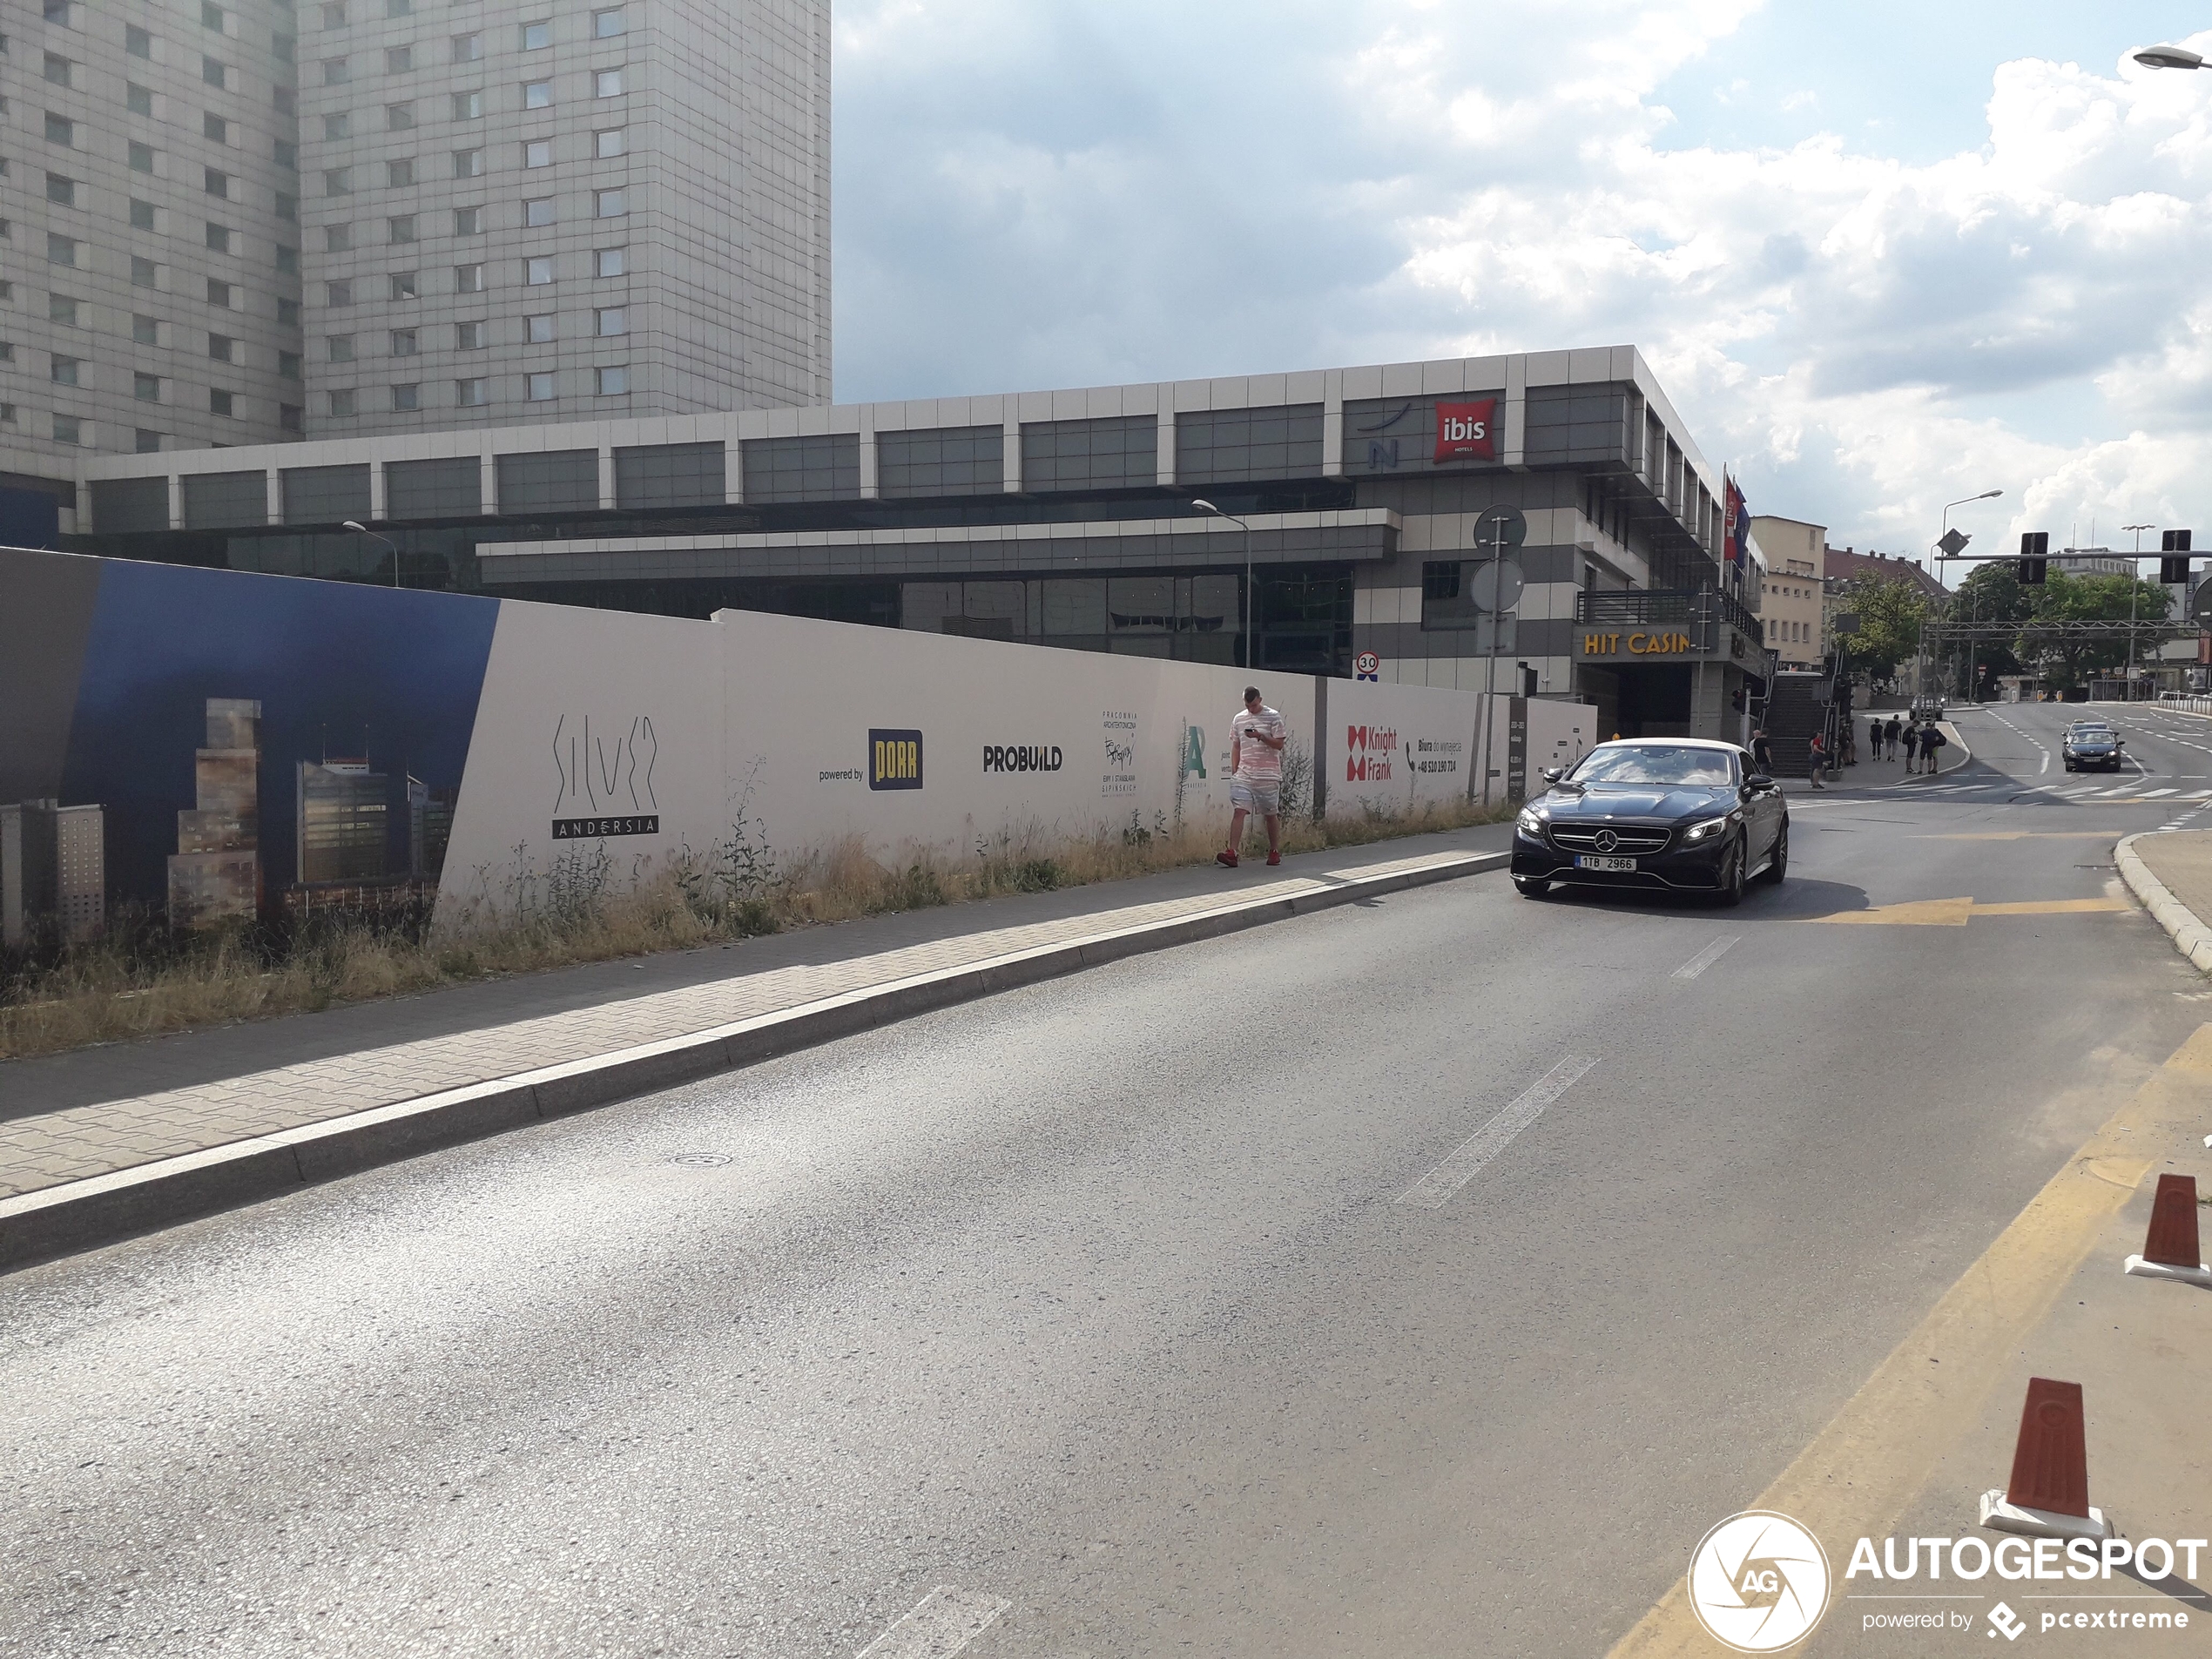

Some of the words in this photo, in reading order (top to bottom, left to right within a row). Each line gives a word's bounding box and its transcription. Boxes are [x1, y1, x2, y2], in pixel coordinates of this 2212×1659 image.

[1444, 416, 1486, 442] ibis
[1584, 634, 1620, 654] HIT
[1628, 632, 1690, 654] CASIN
[1360, 658, 1376, 668] 30
[1368, 725, 1397, 757] Knight
[819, 768, 853, 782] powered
[854, 768, 864, 782] by
[1367, 757, 1393, 781] Frank
[559, 819, 654, 836] ANDERSIA
[1582, 857, 1600, 867] 1TB
[1607, 859, 1632, 869] 2966
